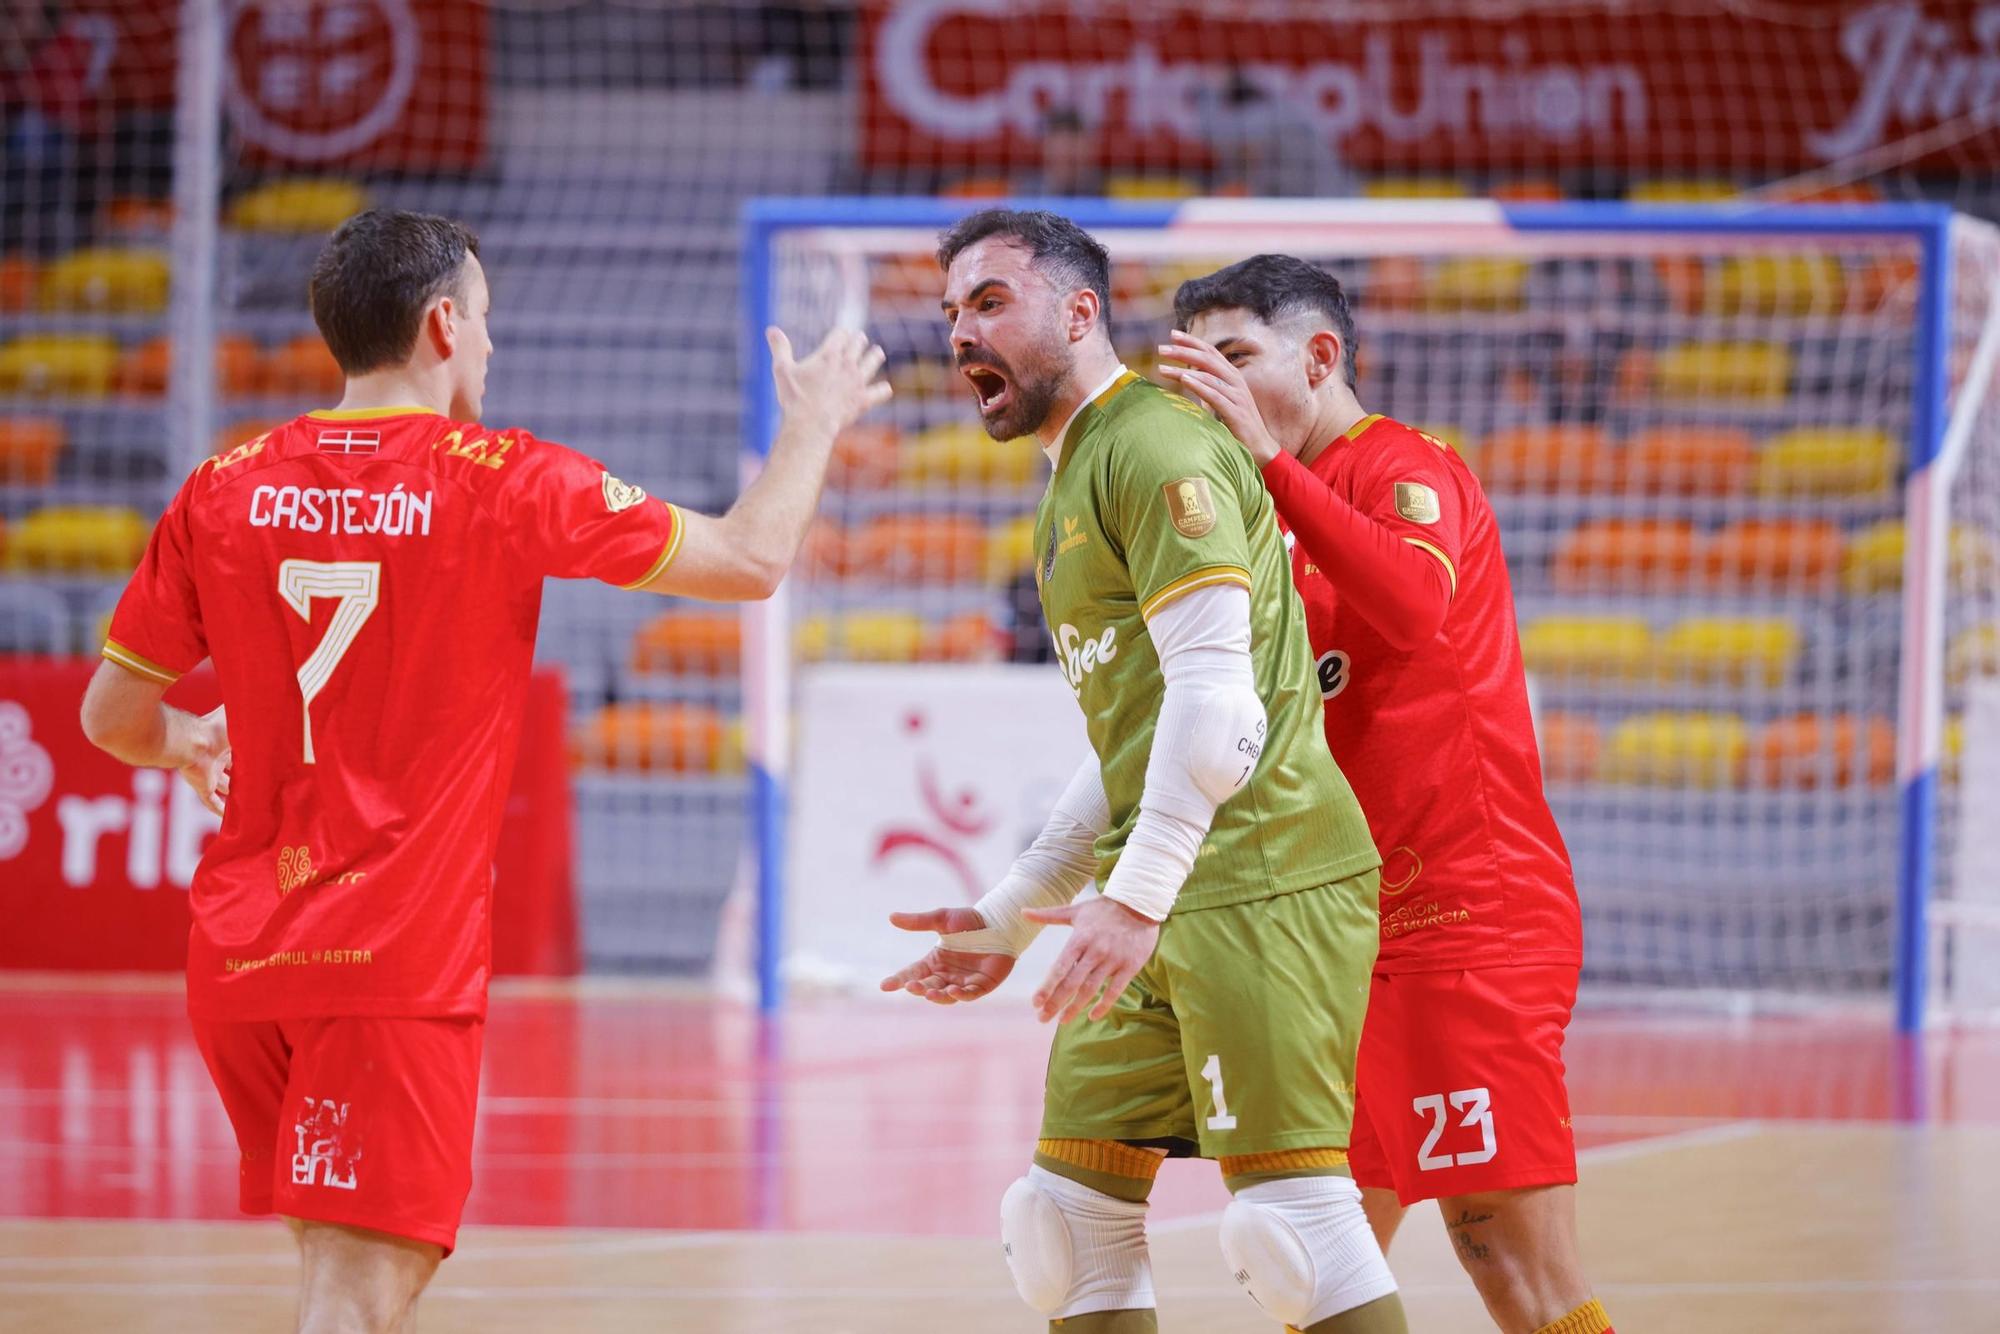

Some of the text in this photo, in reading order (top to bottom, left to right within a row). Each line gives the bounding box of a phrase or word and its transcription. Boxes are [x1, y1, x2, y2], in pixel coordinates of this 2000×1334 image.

[249, 483, 432, 536] CASTEJÓN
[278, 558, 381, 765] 7
[1403, 909, 1470, 932] MURCIA
[269, 950, 309, 967] SIMUL
[323, 950, 372, 964] ASTRA
[1201, 1054, 1237, 1130] 1
[1413, 1087, 1497, 1171] 23
